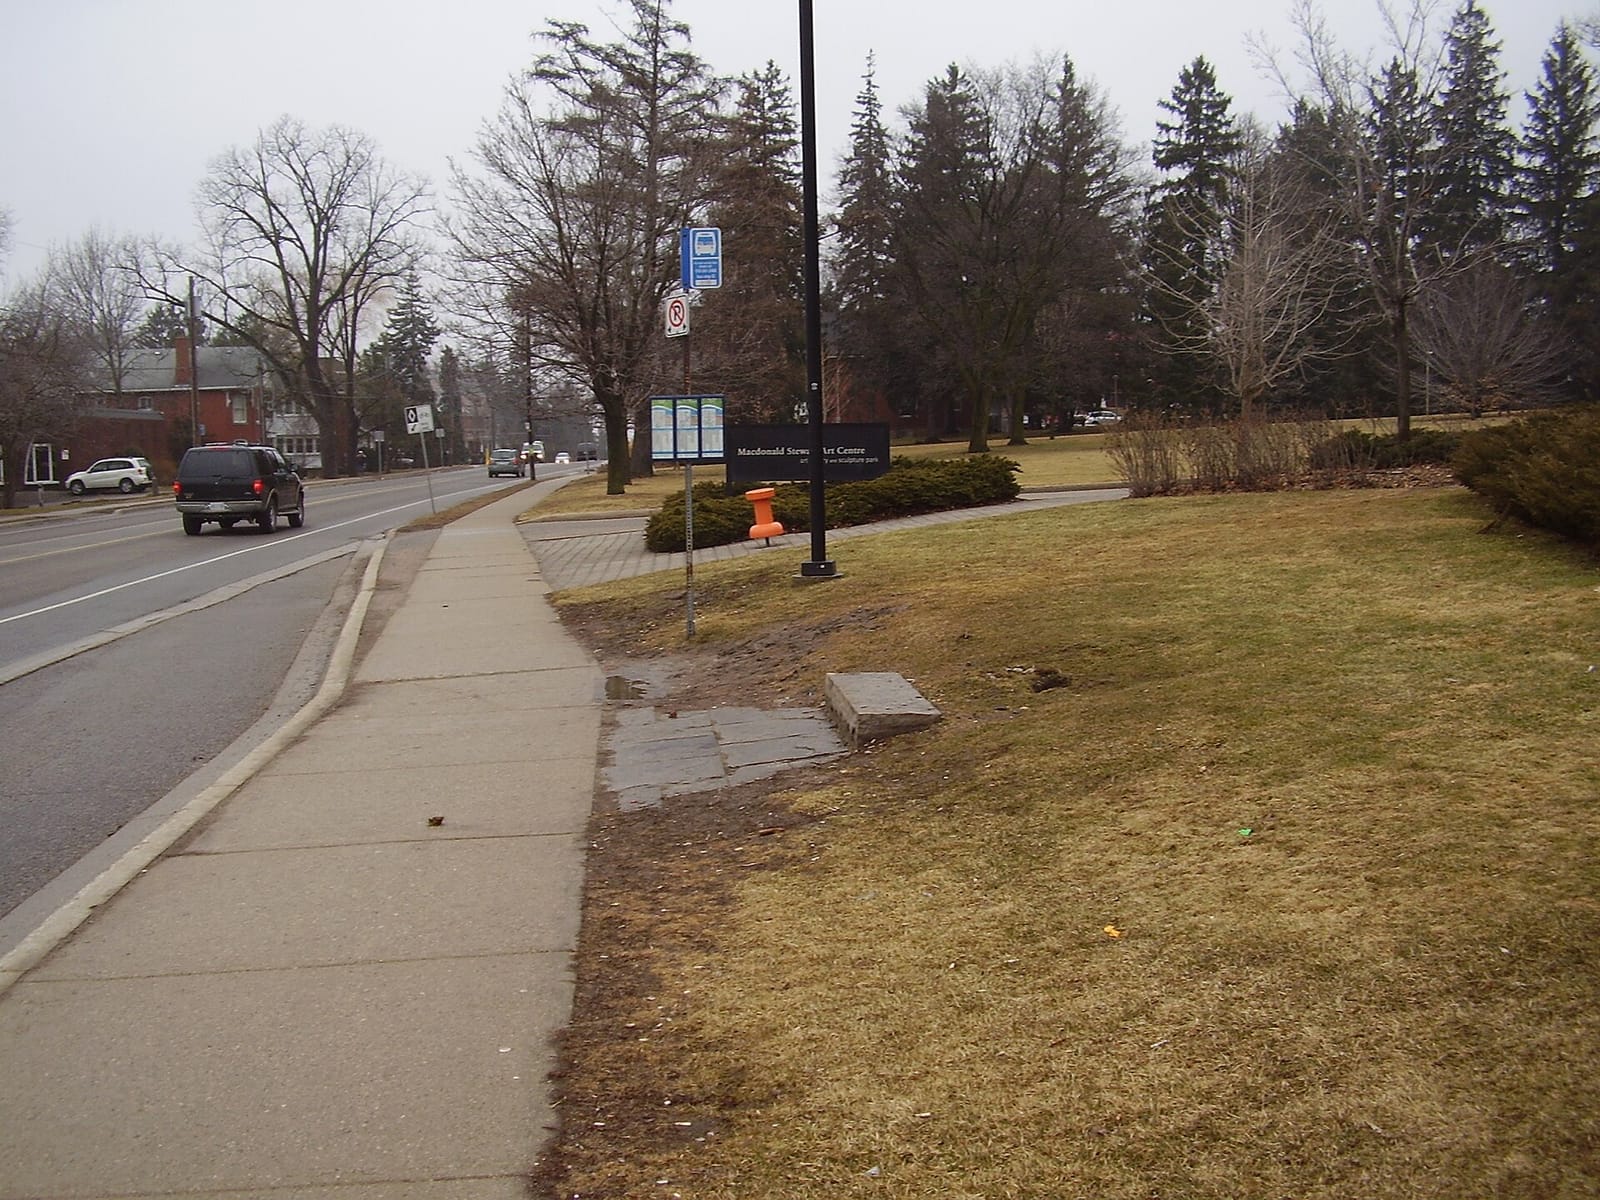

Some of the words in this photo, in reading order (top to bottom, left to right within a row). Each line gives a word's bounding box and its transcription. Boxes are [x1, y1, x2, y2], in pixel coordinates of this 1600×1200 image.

[737, 447, 785, 456] Macdonald
[786, 447, 810, 455] Stewa
[836, 446, 866, 455] Centre
